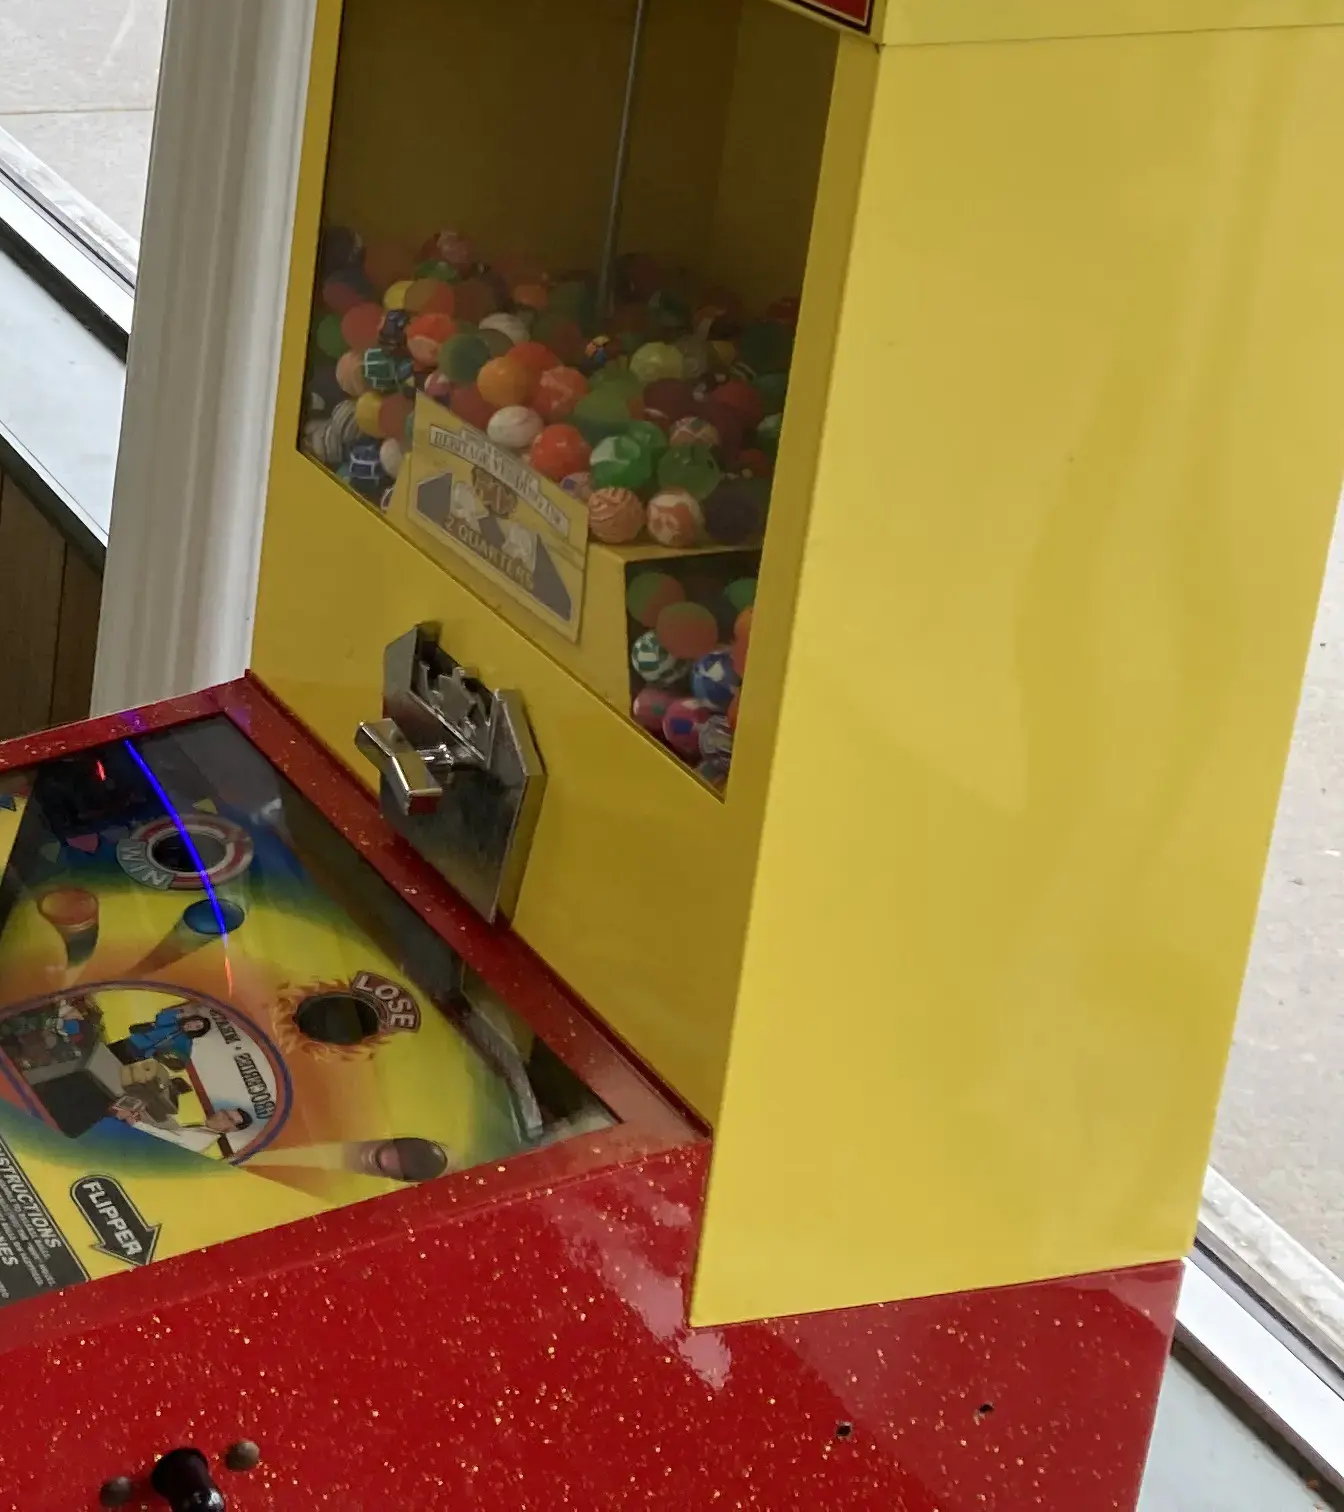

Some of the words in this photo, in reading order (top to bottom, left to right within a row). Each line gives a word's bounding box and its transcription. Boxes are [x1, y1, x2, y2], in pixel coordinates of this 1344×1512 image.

[443, 517, 454, 532] 2
[458, 524, 534, 590] QUARTERS
[128, 844, 172, 889] WIN
[354, 973, 417, 1029] LOSE
[82, 1179, 145, 1257] FLIPPER
